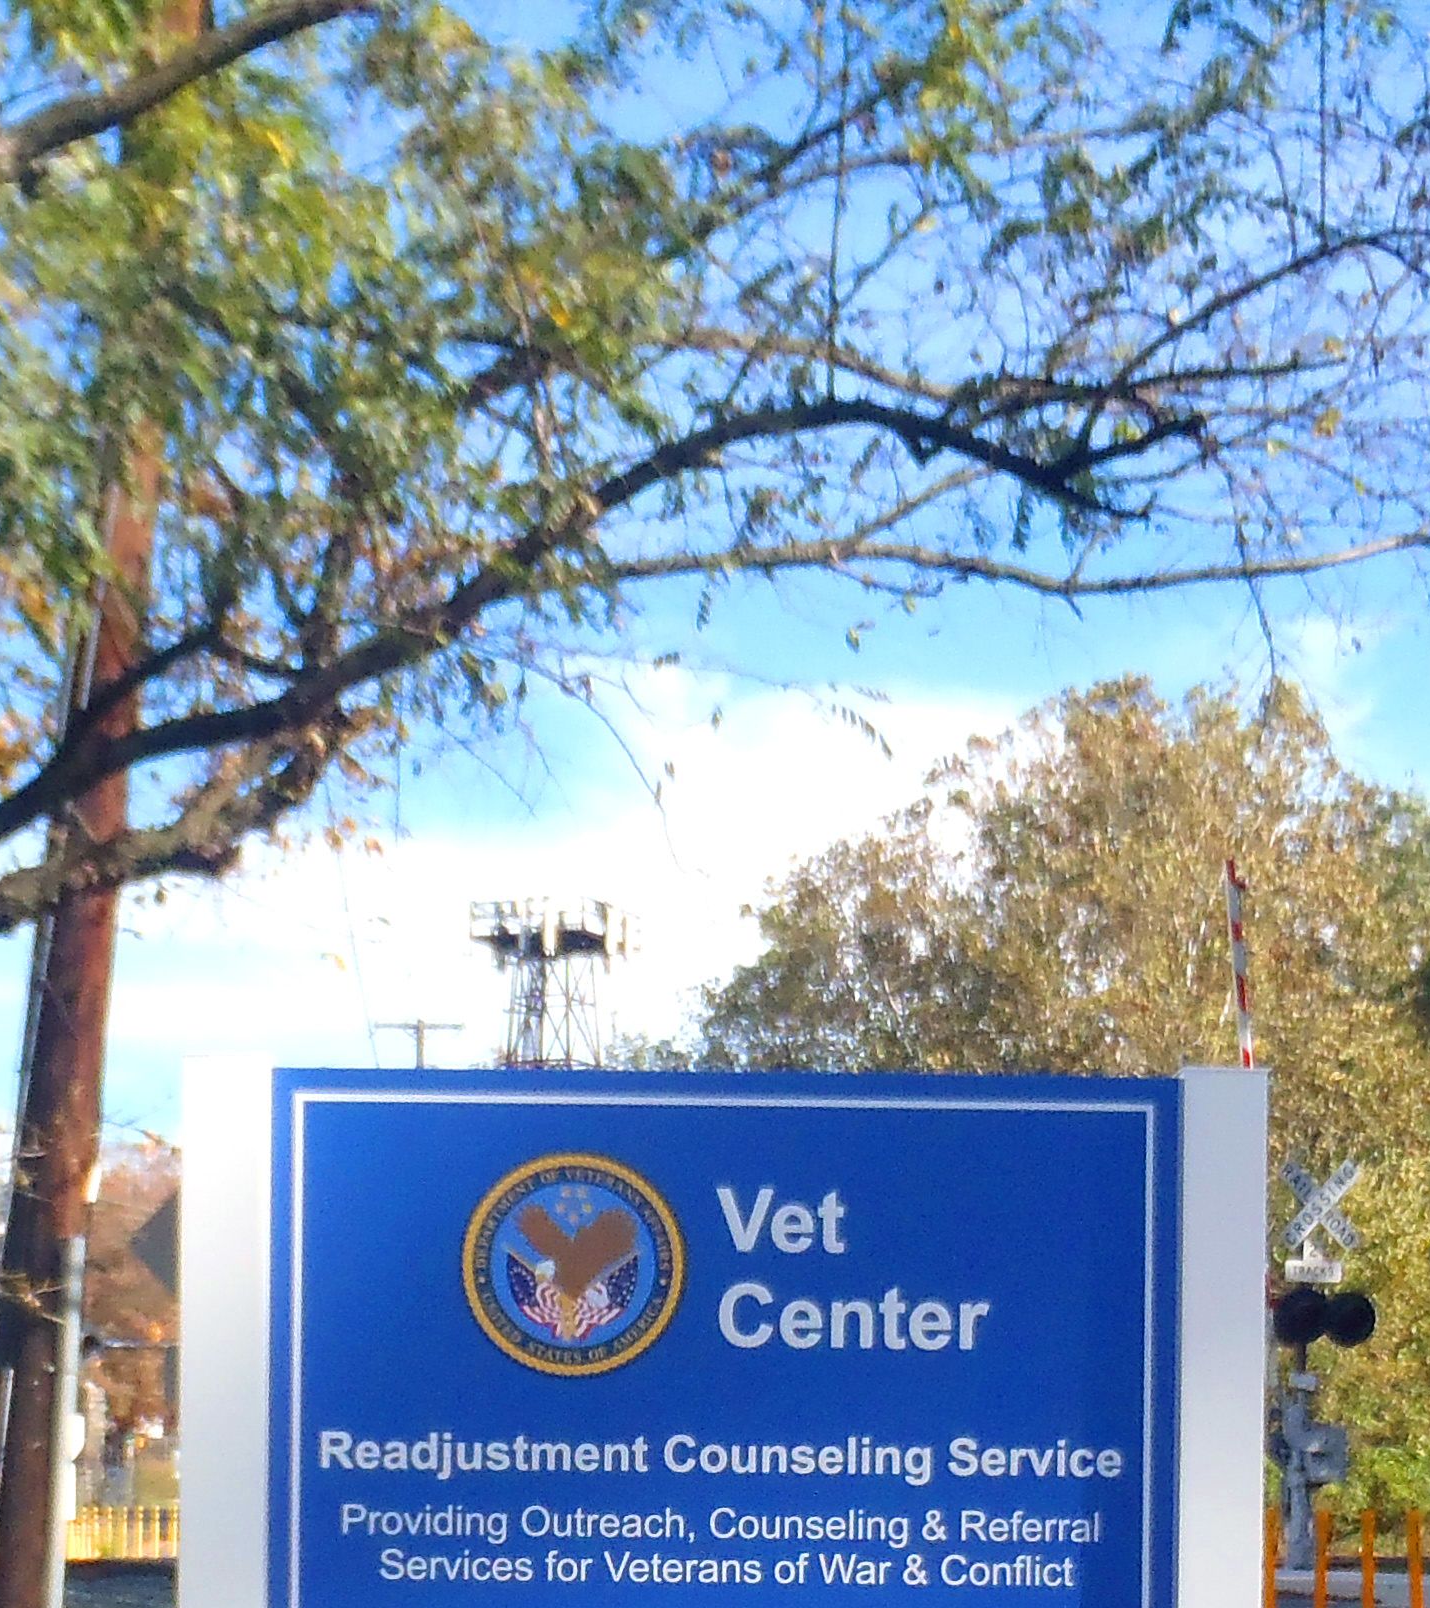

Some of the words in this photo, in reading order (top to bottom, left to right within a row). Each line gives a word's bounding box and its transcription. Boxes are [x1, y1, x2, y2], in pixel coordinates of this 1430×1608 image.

[475, 1182, 535, 1267] DEPARTMENT
[540, 1171, 560, 1184] OF
[564, 1169, 642, 1206] VETERANS
[715, 1184, 848, 1255] Vet
[1284, 1164, 1355, 1246] CROSSING
[1292, 1265, 1335, 1276] TRACKS
[528, 1339, 583, 1364] STATES
[587, 1346, 607, 1362] OF
[612, 1297, 663, 1350] AMERICA
[718, 1280, 991, 1351] Center
[317, 1429, 652, 1481] Readjustment
[663, 1433, 935, 1487] Counseling
[947, 1435, 1125, 1479] Service
[340, 1503, 509, 1545] Providing
[520, 1504, 696, 1544] Outreach,
[709, 1506, 912, 1550] Counseling
[921, 1507, 950, 1544] &
[960, 1507, 1101, 1544] Referral
[378, 1548, 535, 1582] Services
[544, 1549, 594, 1584] for
[603, 1550, 765, 1585] Veterans
[773, 1551, 812, 1585] of
[818, 1552, 895, 1586] War
[902, 1551, 931, 1587] &
[940, 1551, 1077, 1588] Conflict
